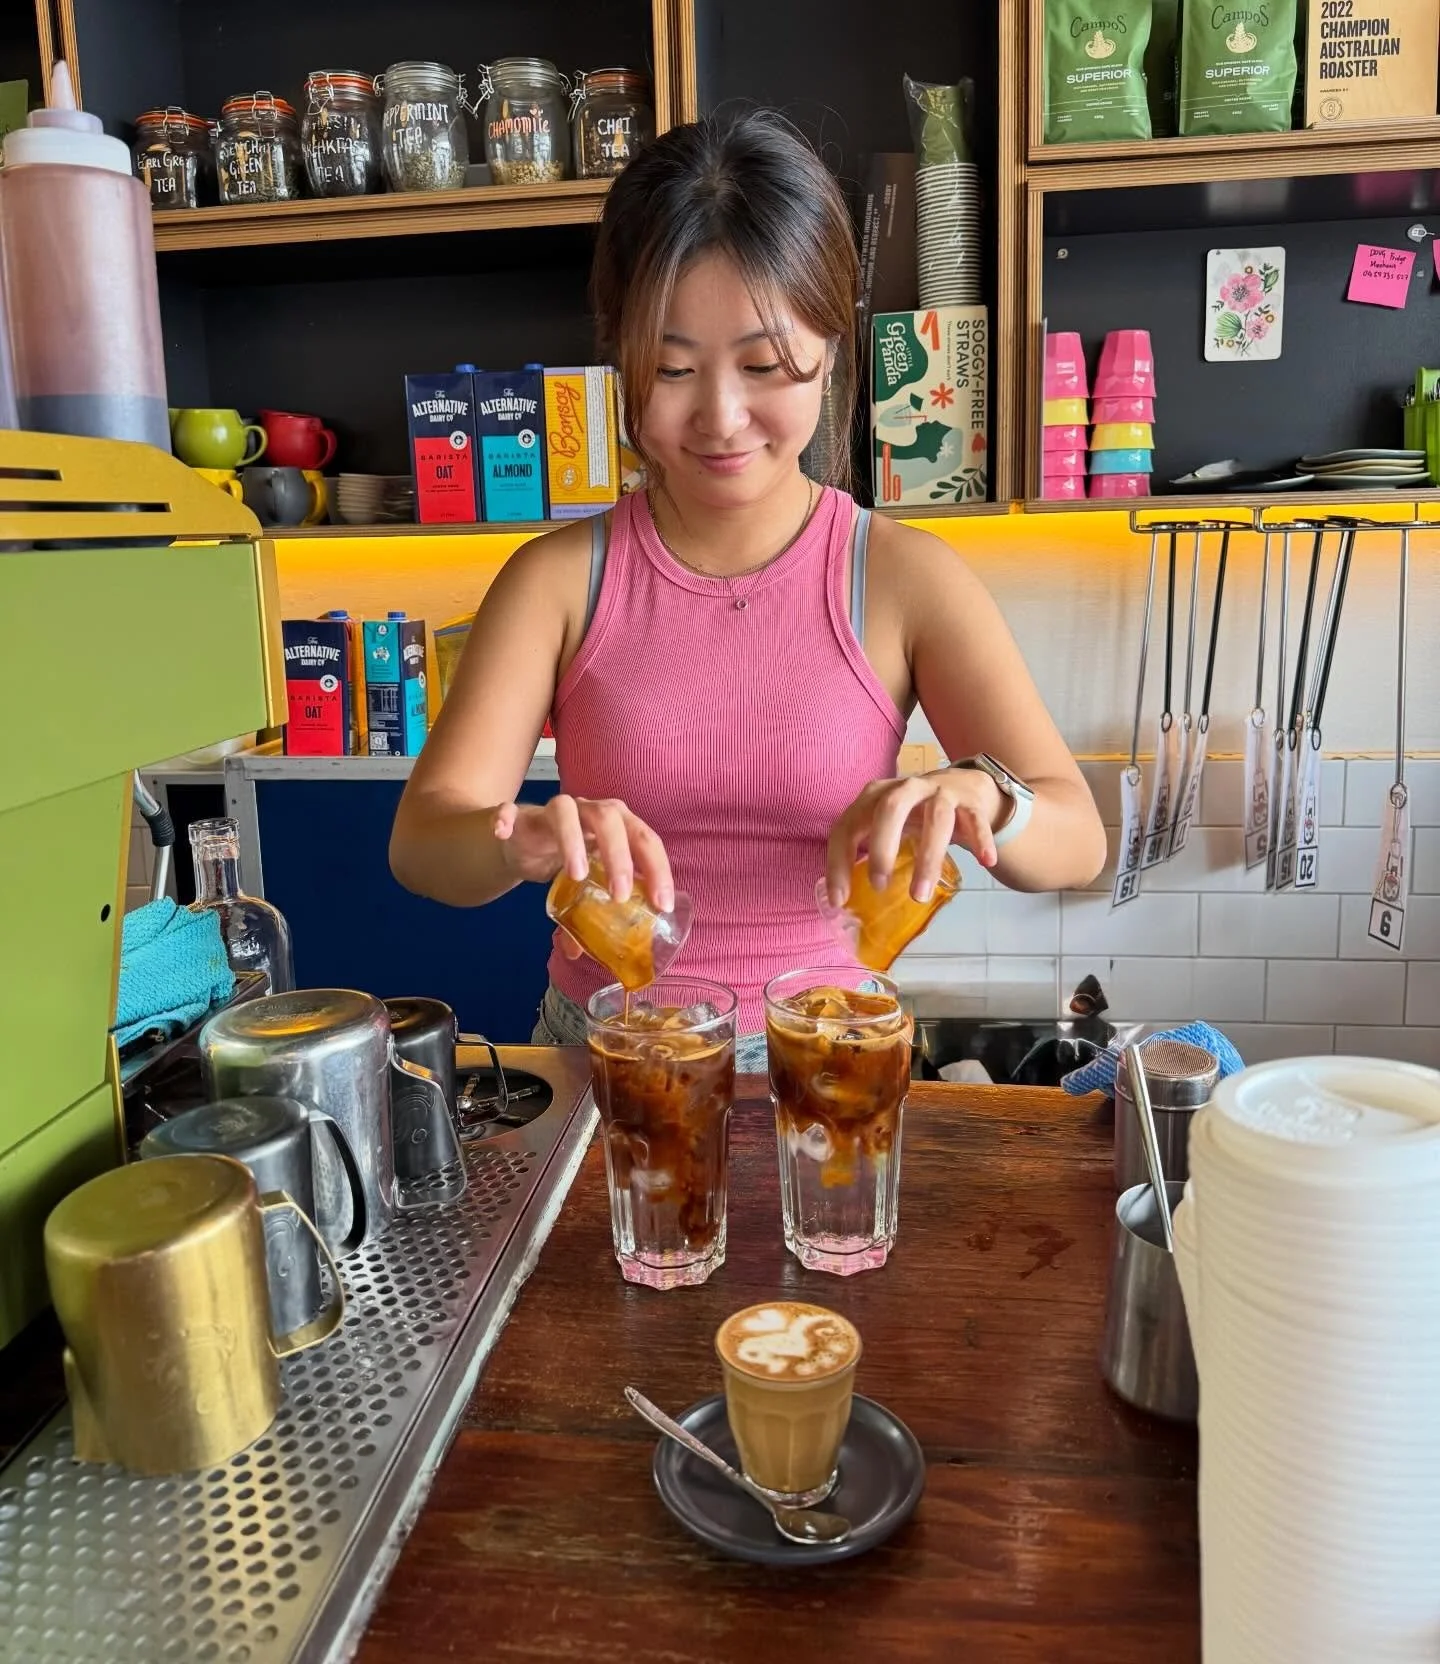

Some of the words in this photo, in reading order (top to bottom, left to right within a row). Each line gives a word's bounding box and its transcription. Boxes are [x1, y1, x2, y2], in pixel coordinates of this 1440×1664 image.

[1321, 0, 1353, 19] 2022
[1321, 18, 1390, 39] CHAMPION
[1320, 38, 1400, 60] AUSTRALIAN
[1066, 69, 1132, 84] SUPERIOR
[1205, 65, 1271, 79] SUPERIOR
[1320, 59, 1378, 80] ROASTER
[597, 117, 631, 135] CHAI
[397, 126, 423, 149] TEA
[602, 142, 630, 158] TEA
[153, 177, 176, 193] TEA
[237, 181, 257, 195] TEA
[886, 322, 909, 372] Green
[956, 320, 970, 389] STRAWS
[879, 336, 902, 386] Panda
[971, 319, 986, 429] SOGGY-FREE
[411, 397, 469, 418] ALTERNATIVE
[480, 396, 538, 417] ALTERNATIVE
[429, 414, 446, 422] DAIRY
[497, 412, 514, 421] DAIRY
[549, 381, 585, 459] Bonsoy
[420, 453, 468, 462] BARISTA
[435, 464, 454, 480] OAT
[492, 463, 533, 479] ALMOND
[285, 645, 341, 661] ALTERNATIVE
[300, 658, 316, 666] DAIRY
[305, 705, 323, 719] OAT
[1299, 855, 1314, 880] 20
